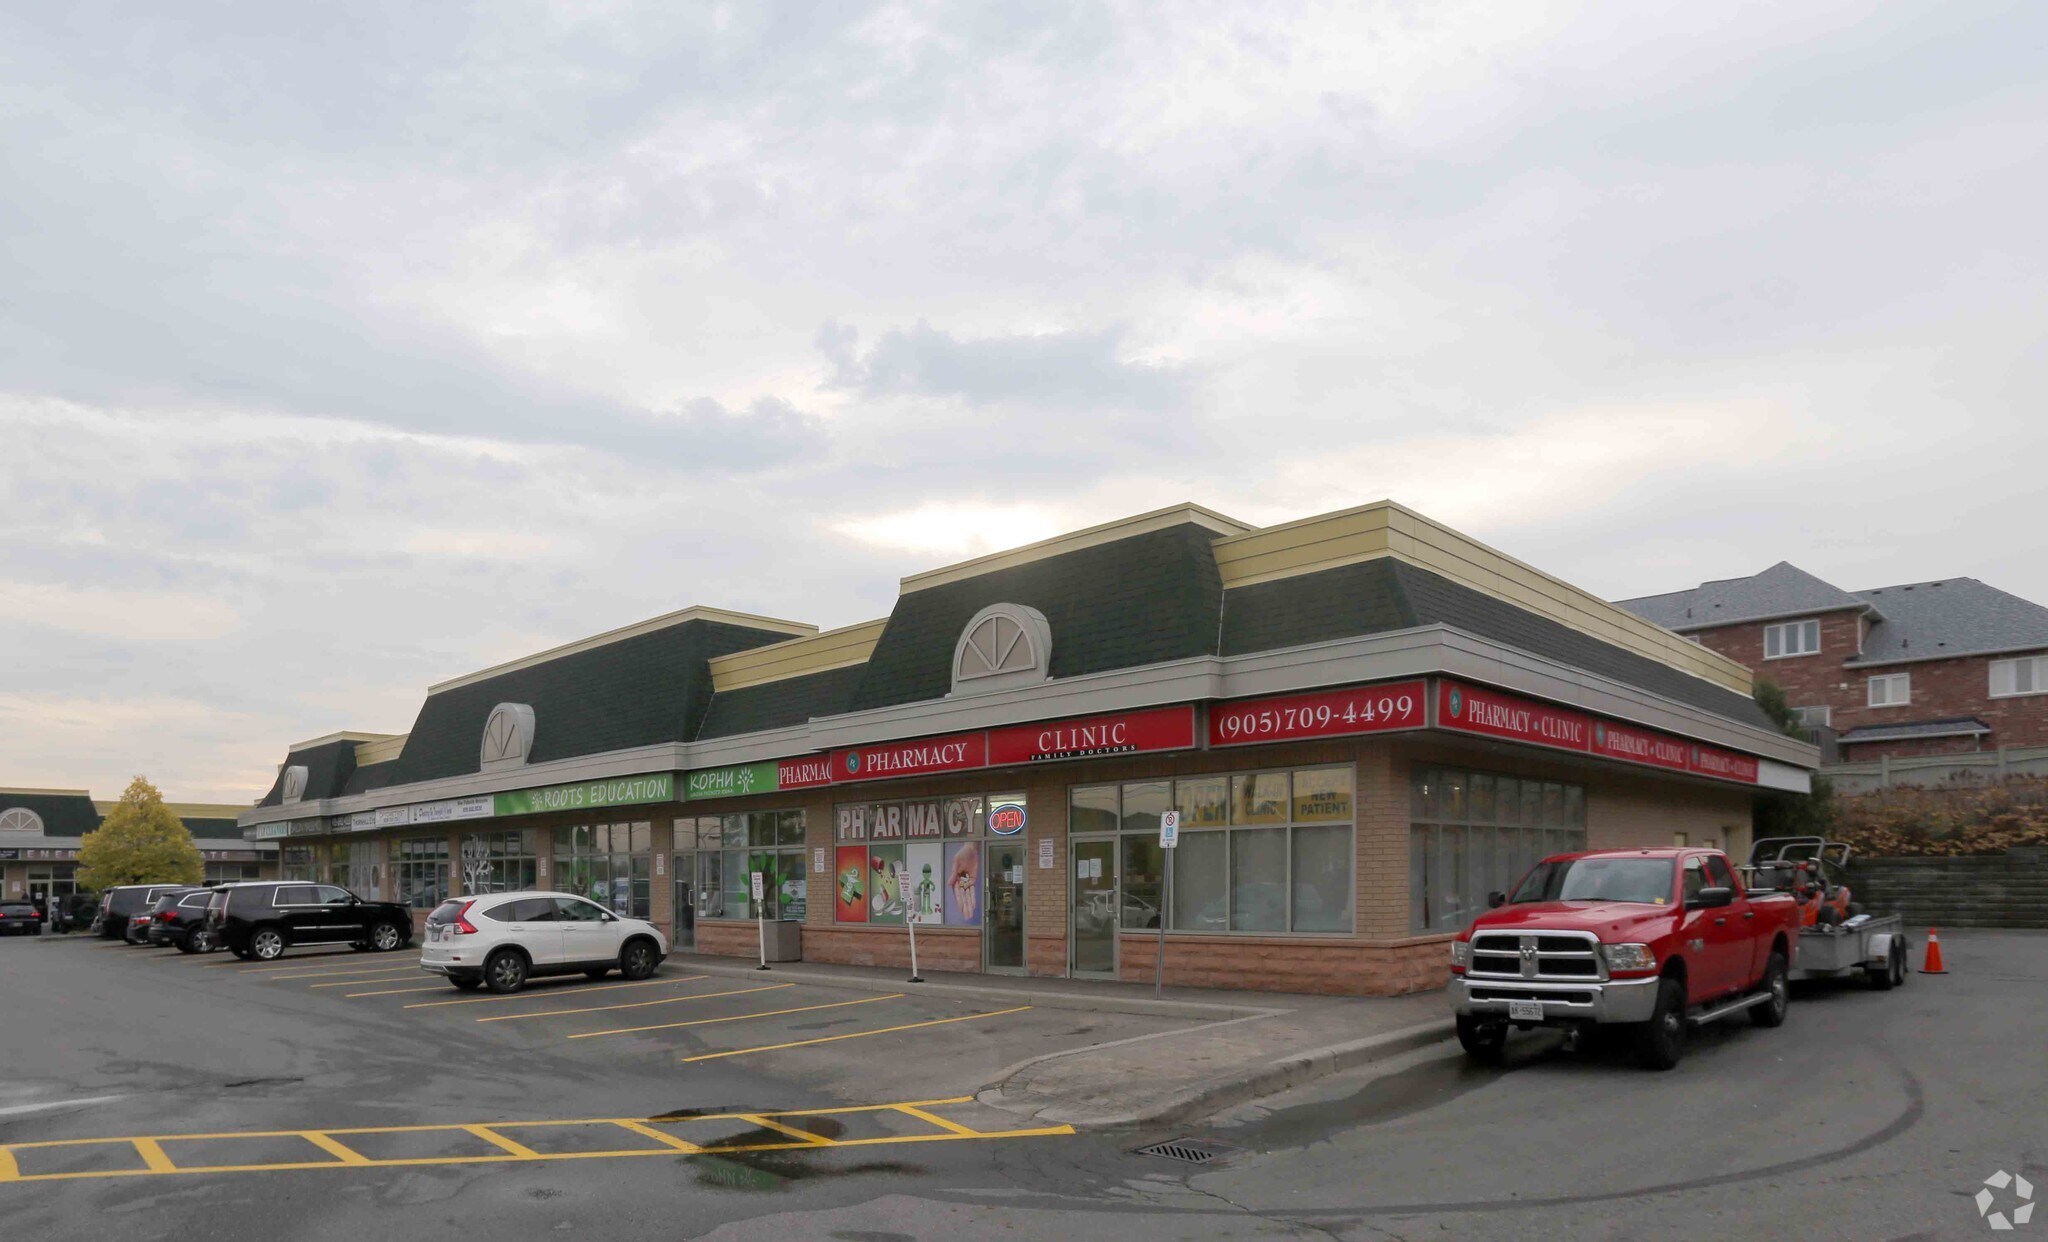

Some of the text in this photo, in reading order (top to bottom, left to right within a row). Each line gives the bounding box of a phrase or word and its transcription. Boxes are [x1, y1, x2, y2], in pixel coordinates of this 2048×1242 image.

[1219, 695, 1413, 739] (905)709-4499
[1468, 699, 1583, 743] PHARMACY CLINIC
[1038, 723, 1127, 751] CLINIC
[1607, 730, 1684, 764] PHARMACY CLINIC
[866, 743, 968, 772] PHARMACY
[1031, 744, 1137, 761] FAMILY DOCTORS
[543, 786, 583, 808] ROOTS
[590, 778, 668, 803] EDUCATION
[690, 770, 734, 791] КОРНИ
[1301, 802, 1348, 817] PATIENT
[1311, 789, 1337, 802] NEW
[991, 810, 1023, 829] OPEN
